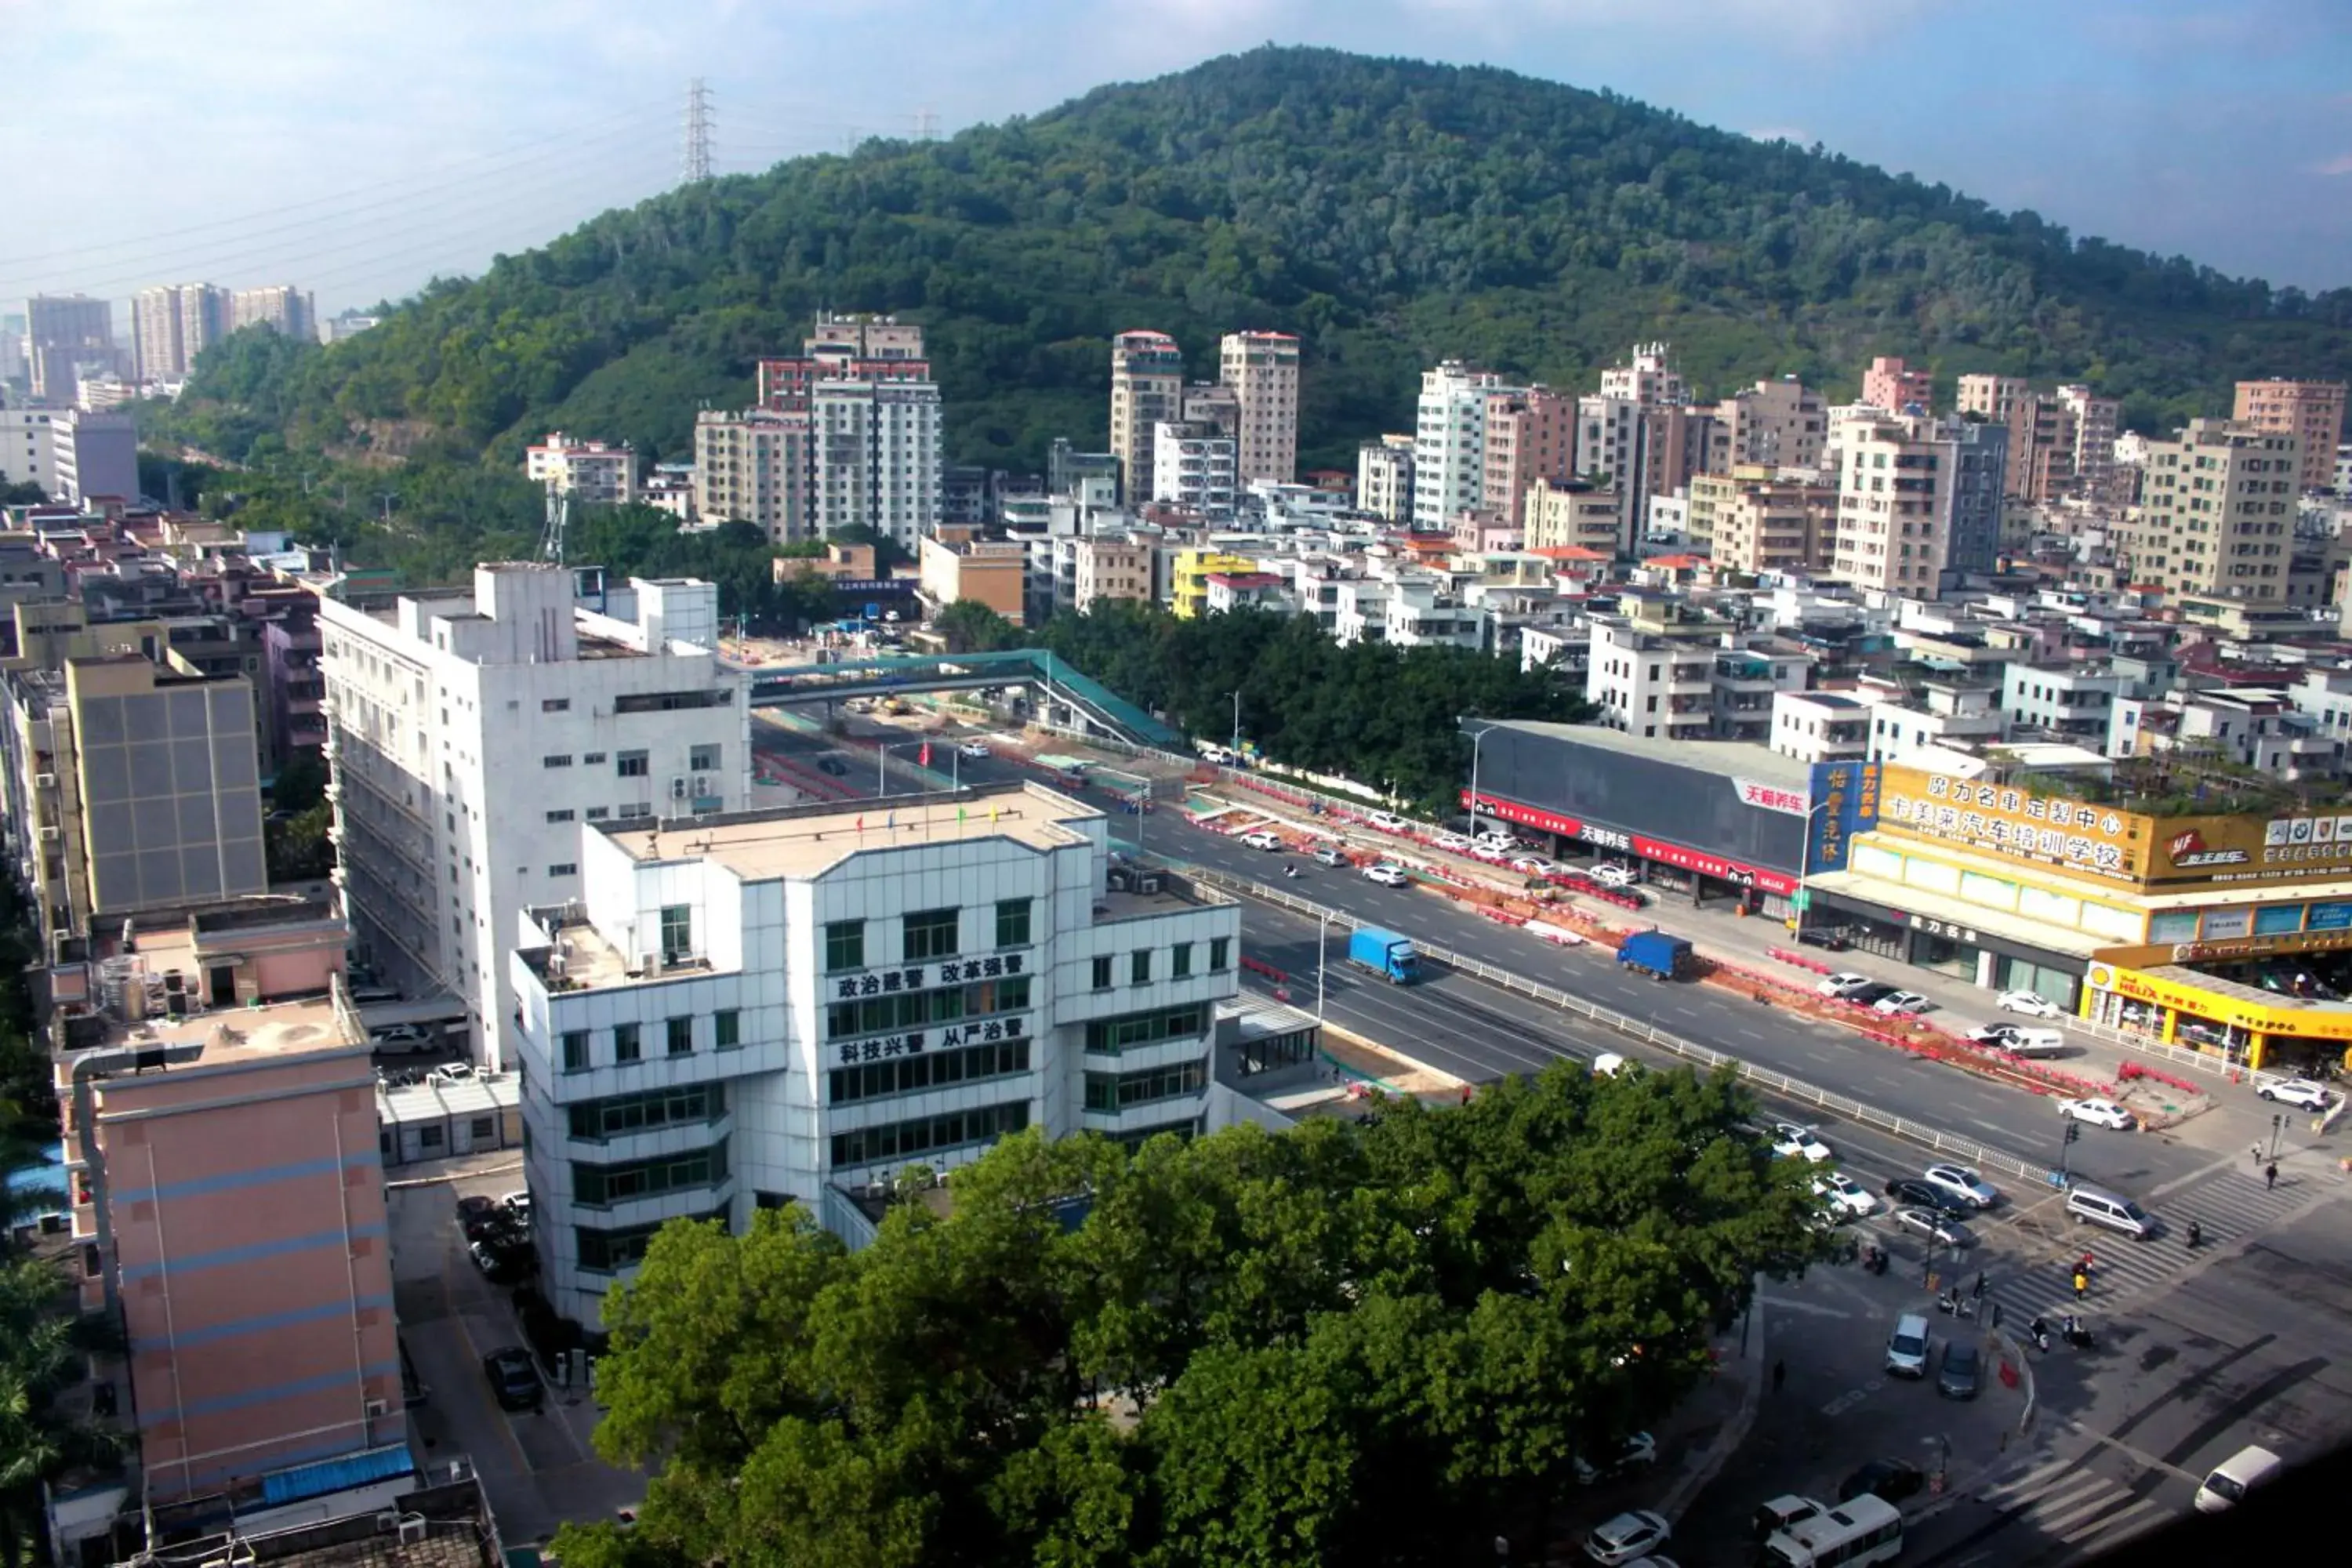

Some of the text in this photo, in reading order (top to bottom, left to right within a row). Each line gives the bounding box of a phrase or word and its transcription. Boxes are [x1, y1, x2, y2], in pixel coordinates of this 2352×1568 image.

[1746, 785, 1803, 811] 天猫养车
[1581, 824, 1630, 851] 天猫养车
[839, 954, 1022, 998] 政治建警 改革强警
[2119, 982, 2158, 1000] HELIX
[840, 1017, 1022, 1065] 科技兴警 从严治警
